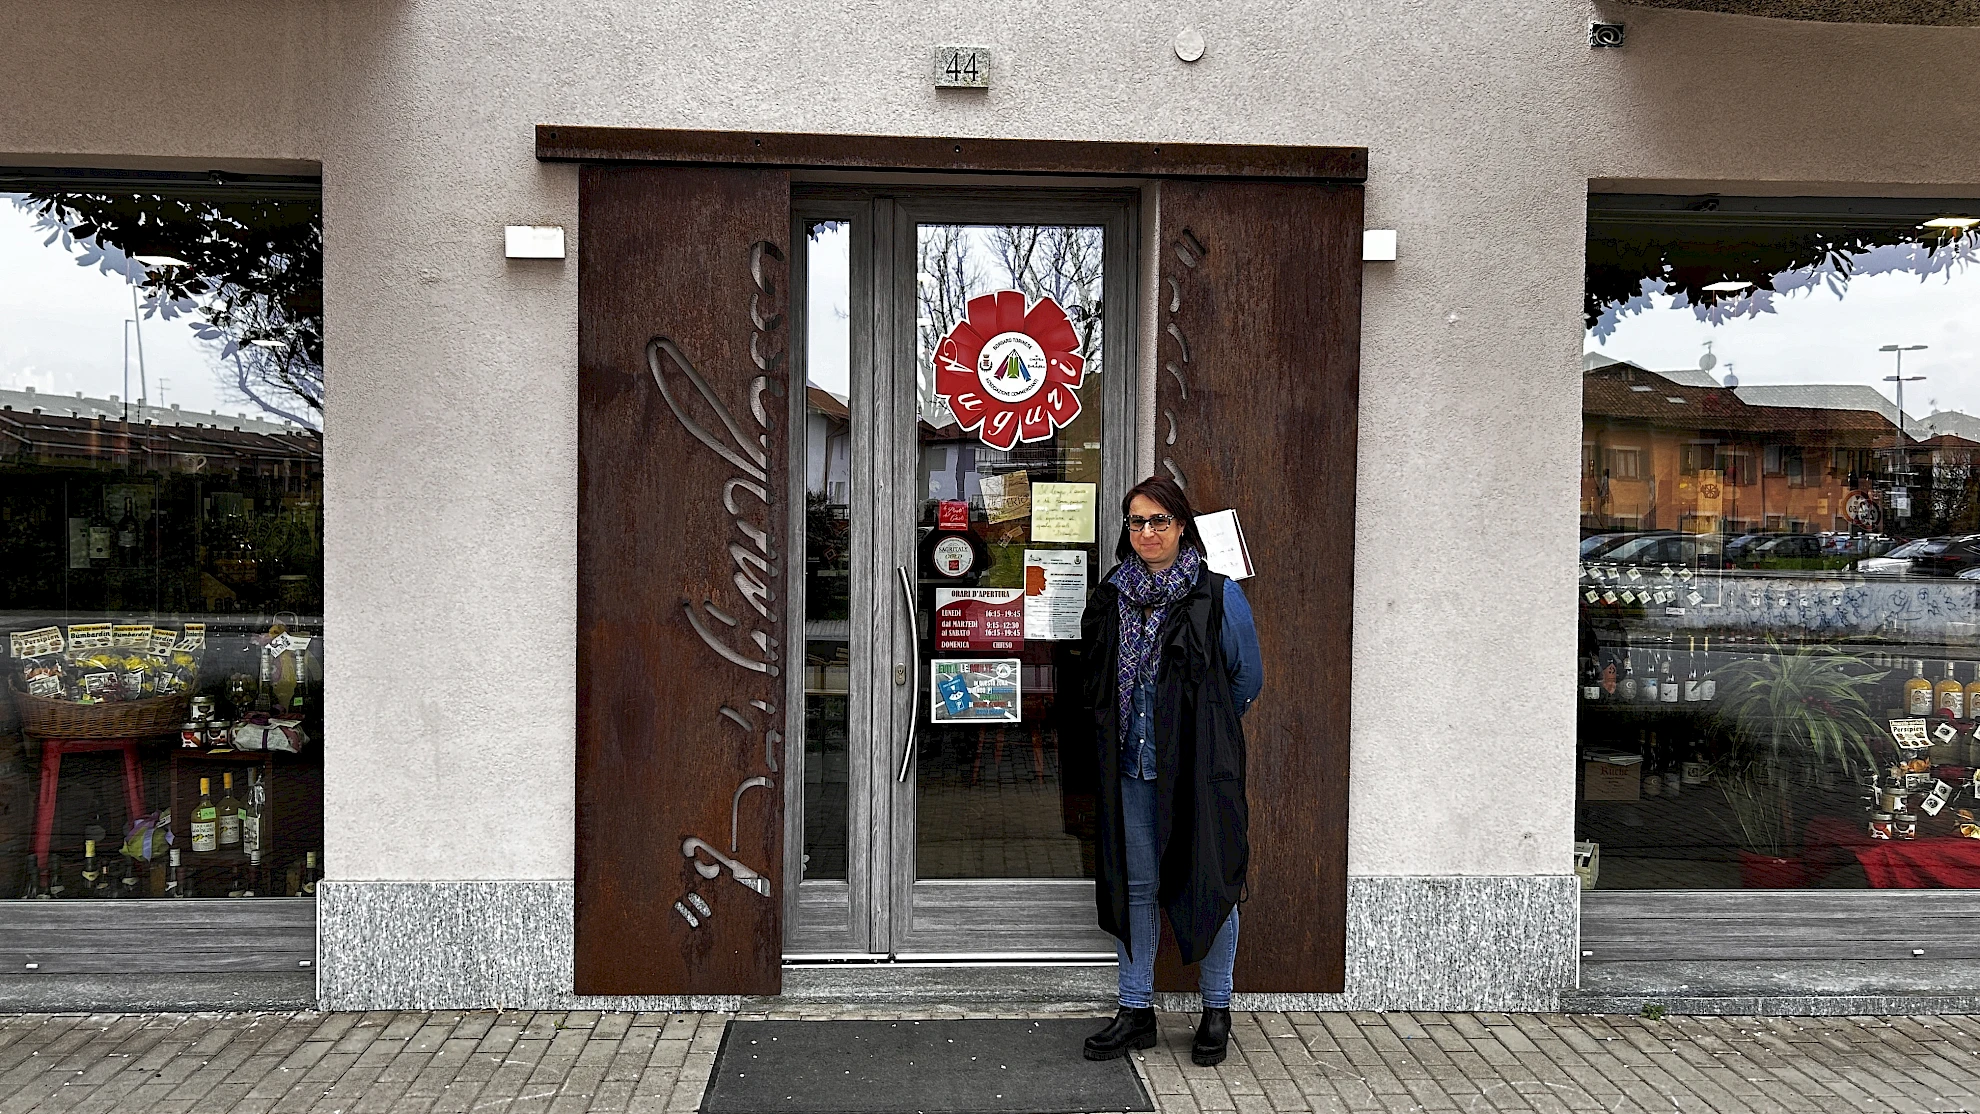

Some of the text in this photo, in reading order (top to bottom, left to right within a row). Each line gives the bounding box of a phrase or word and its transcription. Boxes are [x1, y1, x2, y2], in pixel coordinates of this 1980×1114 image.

[946, 52, 979, 81] 44
[937, 339, 1077, 436] Auguri
[951, 590, 1010, 598] ORARI D'APERTURA
[941, 620, 951, 628] dal
[941, 629, 971, 637] al SABATO
[941, 641, 970, 649] DOMENICA
[992, 641, 1013, 649] CHIUSO
[960, 663, 969, 673] LE
